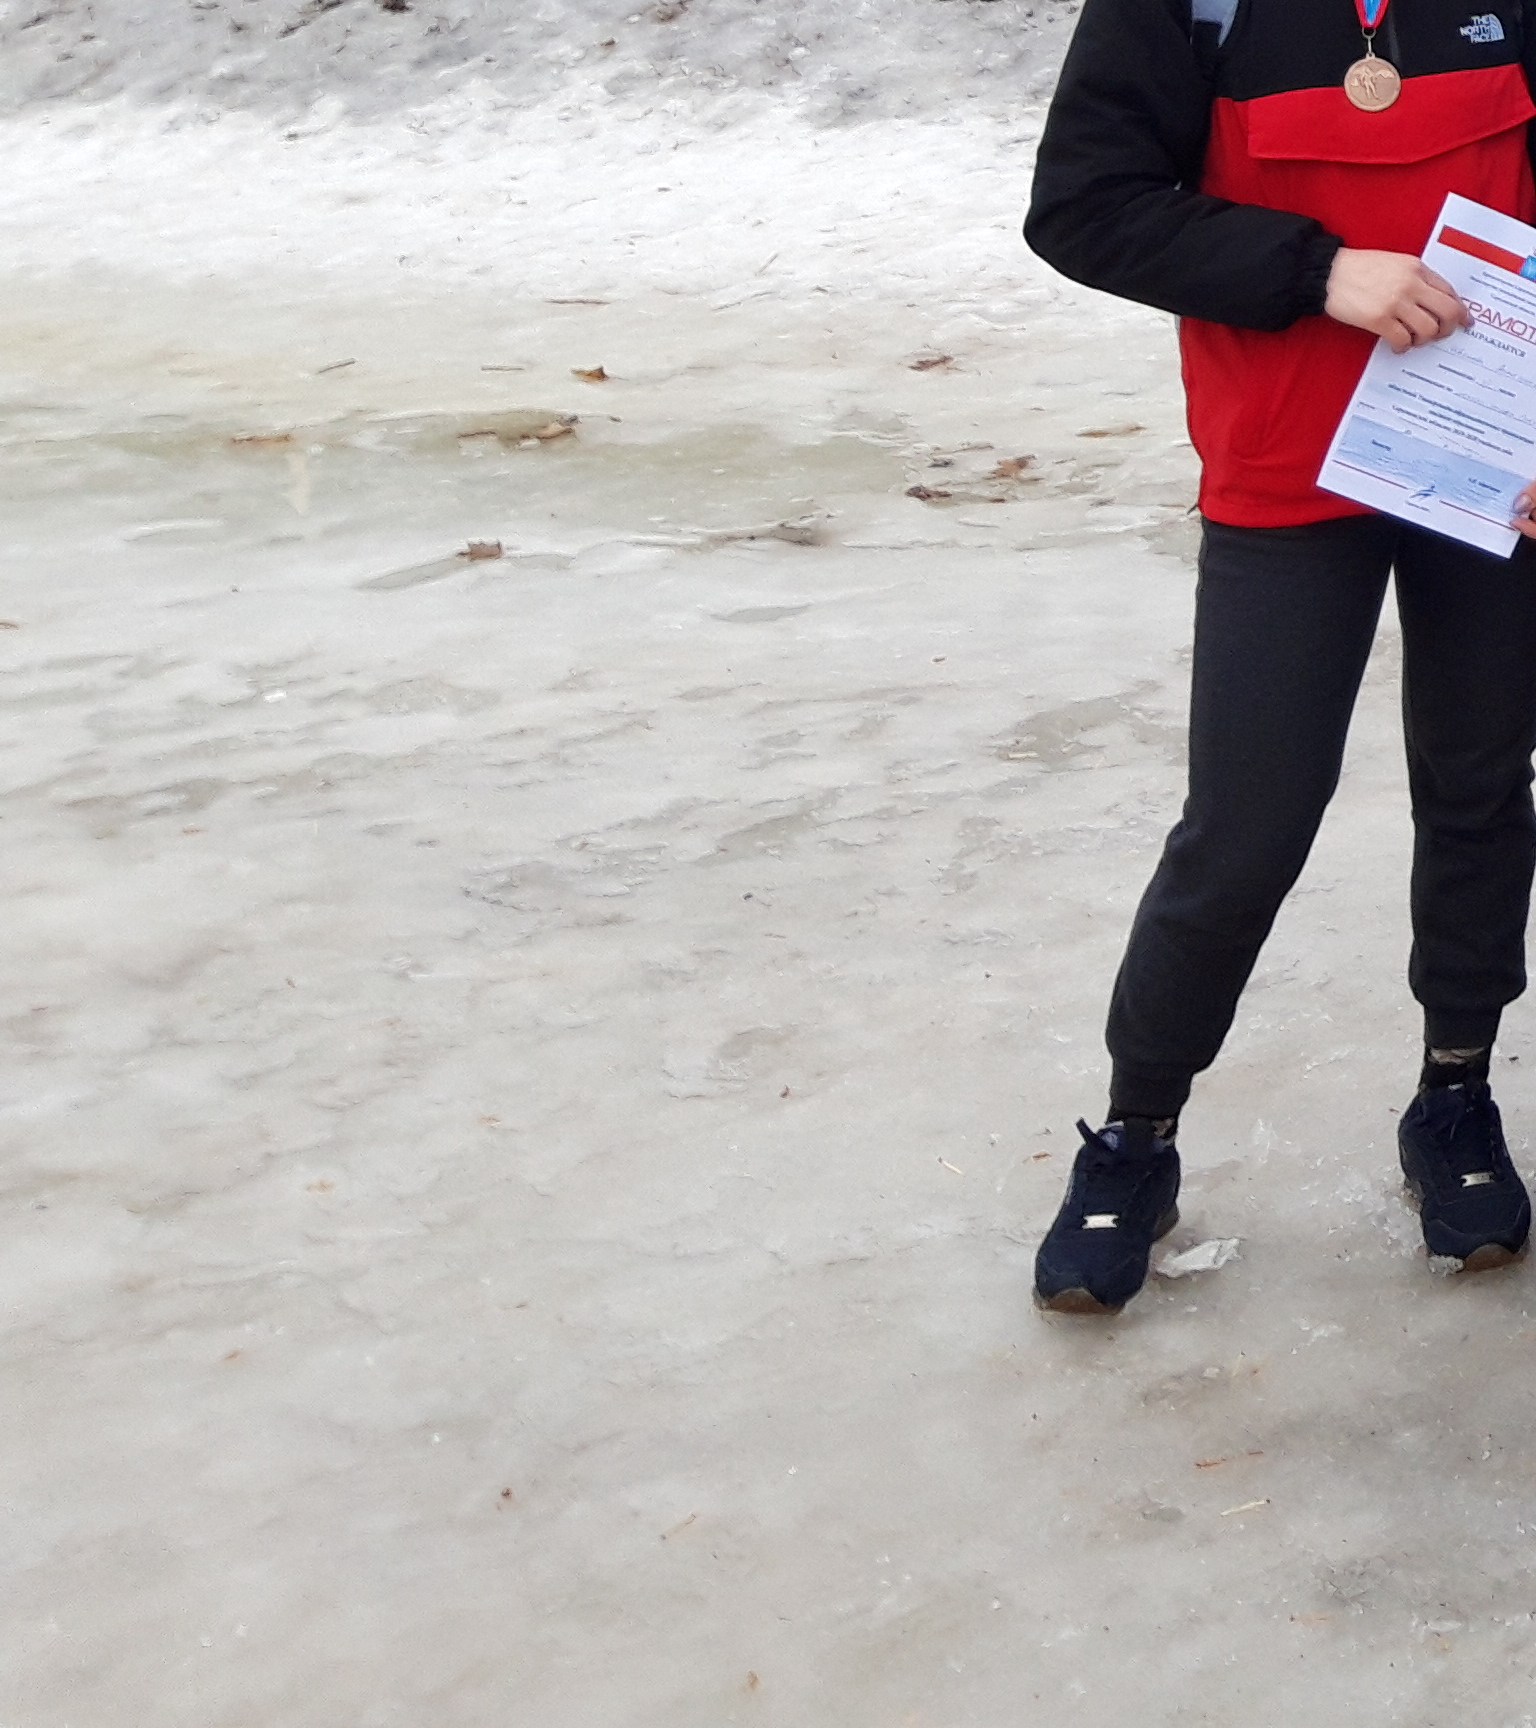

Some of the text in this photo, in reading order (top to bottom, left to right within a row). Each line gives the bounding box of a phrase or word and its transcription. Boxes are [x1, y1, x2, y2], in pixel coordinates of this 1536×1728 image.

[1470, 15, 1490, 25] THE
[1459, 24, 1490, 36] NORTH
[1470, 33, 1491, 43] FACE
